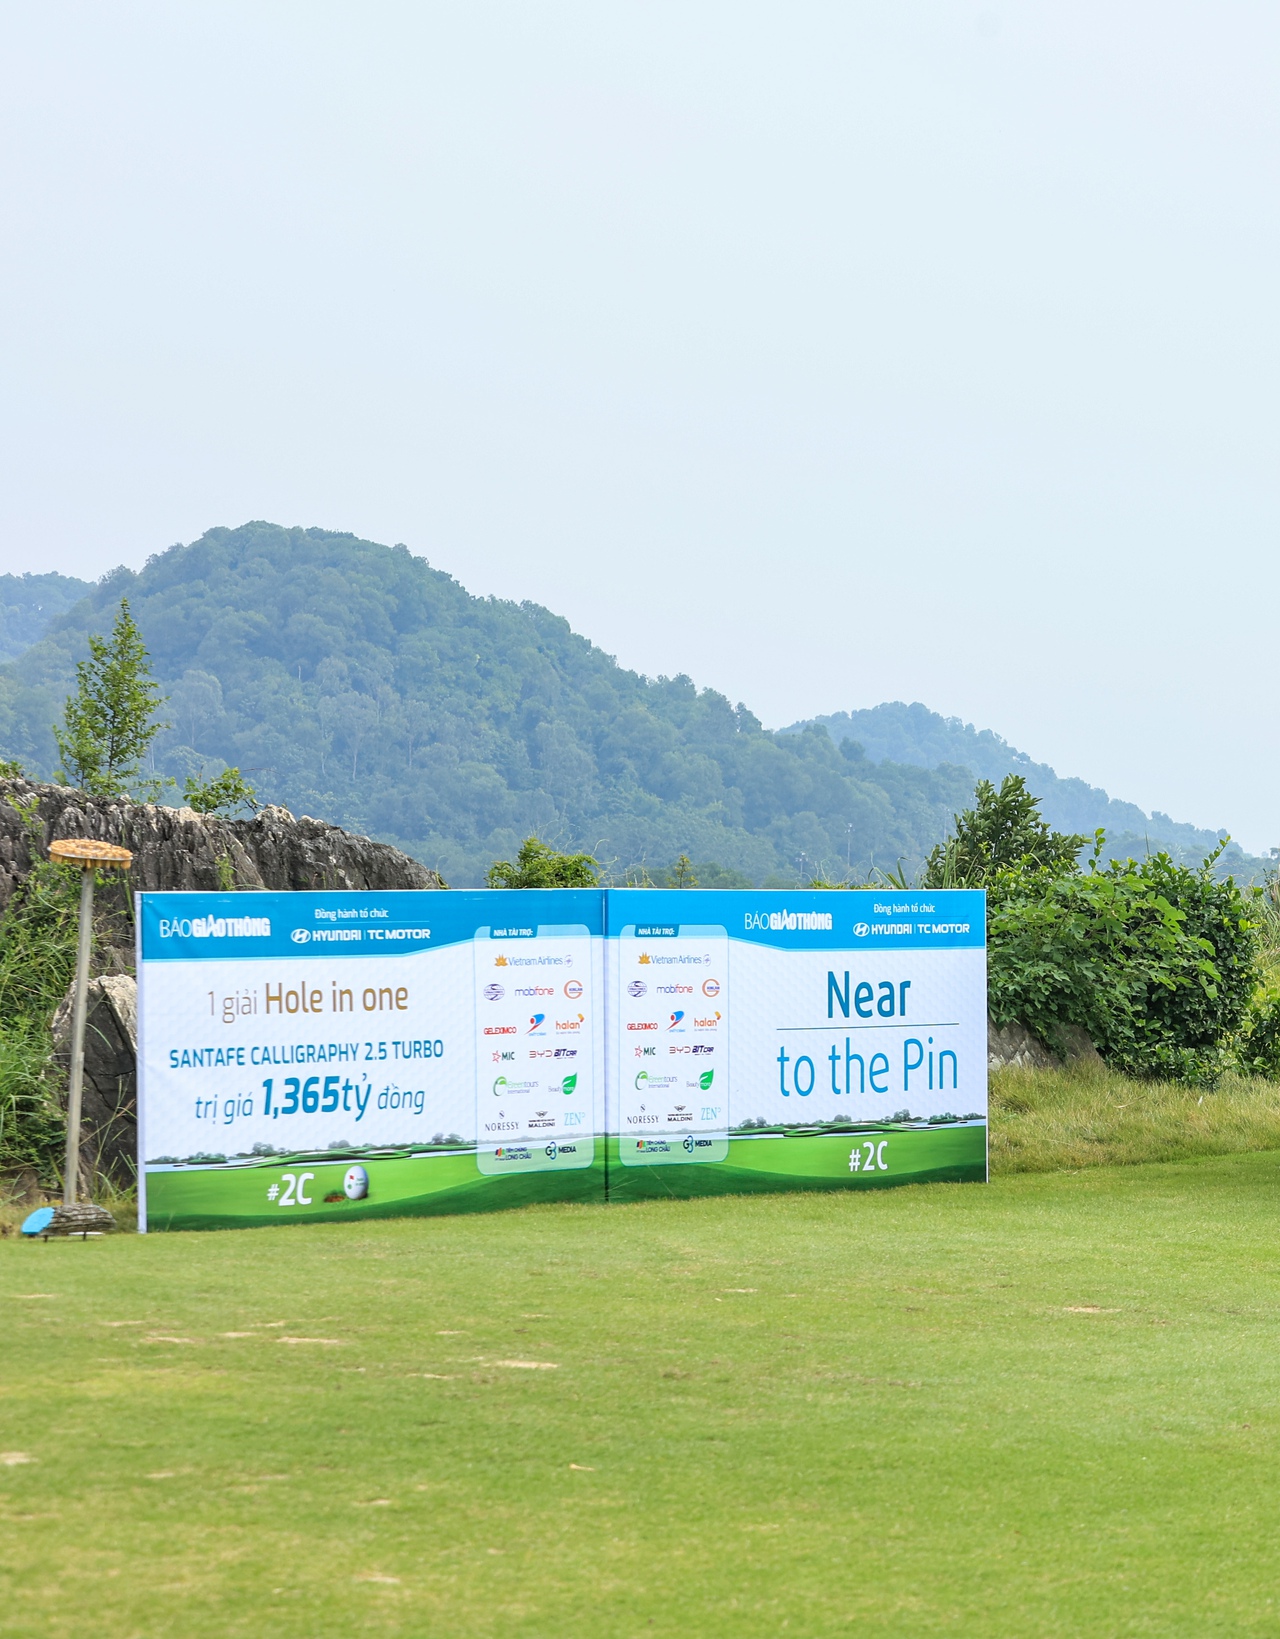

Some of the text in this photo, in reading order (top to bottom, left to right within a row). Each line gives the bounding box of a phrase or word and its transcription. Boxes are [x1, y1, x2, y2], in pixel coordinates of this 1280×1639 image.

[338, 908, 358, 918] hành
[893, 903, 910, 913] hành
[871, 924, 912, 935] HYUNDAI
[932, 924, 970, 934] MOTOR
[312, 929, 361, 941] HYUNDAI
[385, 929, 431, 940] MOTOR
[515, 986, 554, 996] mobifone
[656, 984, 693, 993] mobifone
[827, 970, 911, 1019] Near
[207, 981, 408, 1024] 1 giải Hole in one
[555, 1020, 580, 1030] halan
[694, 1017, 717, 1027] halan
[170, 1039, 444, 1068] SANTAFE CALLIGRAPHY 2.5 TURBO
[777, 1036, 958, 1097] to the Pin
[195, 1094, 218, 1125] trị
[223, 1092, 254, 1125] giá
[377, 1083, 425, 1115] đồng
[627, 1115, 659, 1124] NORESSY
[485, 1121, 519, 1131] NORESSY
[558, 1146, 577, 1154] MEDIA
[848, 1141, 889, 1172] #2C
[267, 1172, 315, 1207] #2C
